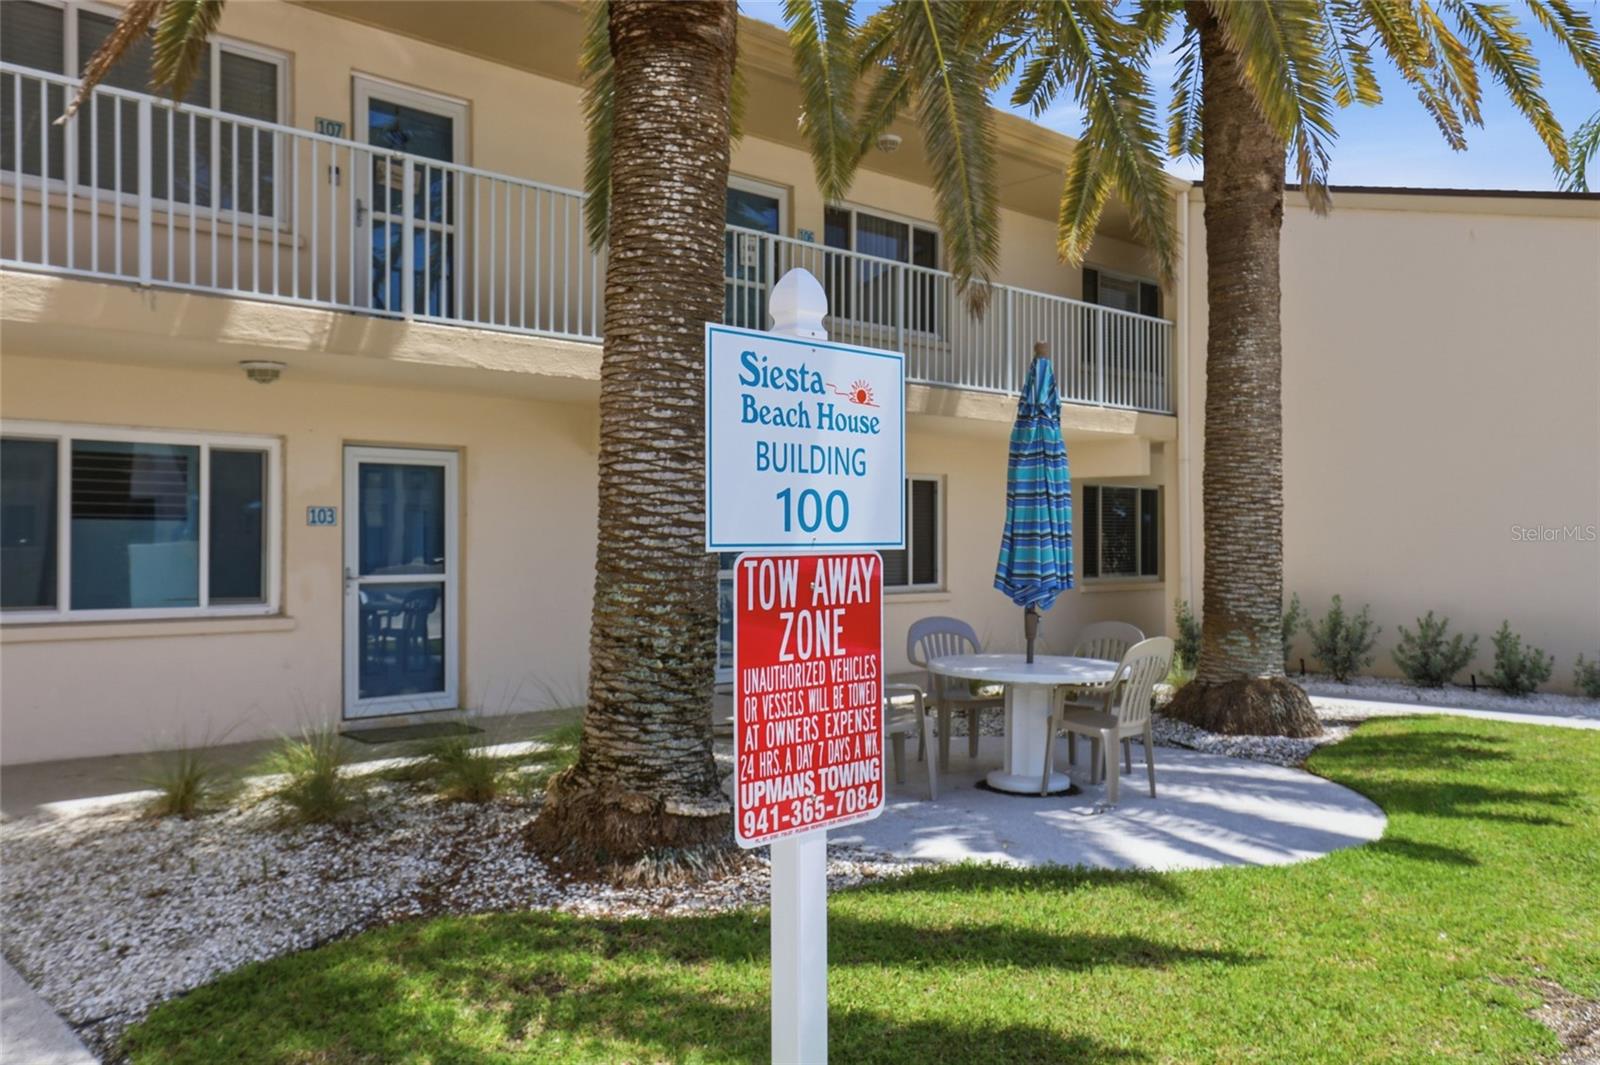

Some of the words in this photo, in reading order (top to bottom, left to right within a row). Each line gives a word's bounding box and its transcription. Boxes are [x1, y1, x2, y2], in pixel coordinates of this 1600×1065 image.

[319, 120, 342, 138] 107
[738, 351, 826, 395] Siesta
[741, 393, 810, 429] Beach
[817, 402, 881, 435] House
[756, 441, 866, 477] BUILDING
[310, 508, 335, 524] 103
[776, 487, 849, 533] 100
[744, 558, 799, 611] TOW
[811, 556, 875, 607] AWAY
[779, 608, 846, 662] ZONE
[743, 660, 826, 695] UNAUTHORIZED
[830, 654, 877, 683] VEHICLES
[743, 697, 758, 723] OR
[762, 690, 804, 720] VESSELS
[808, 686, 829, 713] WILL
[833, 685, 844, 710] BE
[848, 681, 877, 708] TOWED
[745, 724, 760, 752] AT
[766, 715, 819, 748] OWNERS
[825, 707, 877, 738] EXPENSE
[740, 755, 754, 782] 24
[759, 749, 783, 777] HRS.
[785, 747, 793, 773] A
[796, 743, 814, 770] DAY
[818, 742, 825, 766] 7
[828, 735, 851, 764] DAYS
[854, 735, 861, 759] A
[864, 732, 881, 757] WK.
[741, 770, 815, 810] UPMANS
[818, 757, 881, 793] TOWING
[743, 783, 878, 838] 941-365-7084
